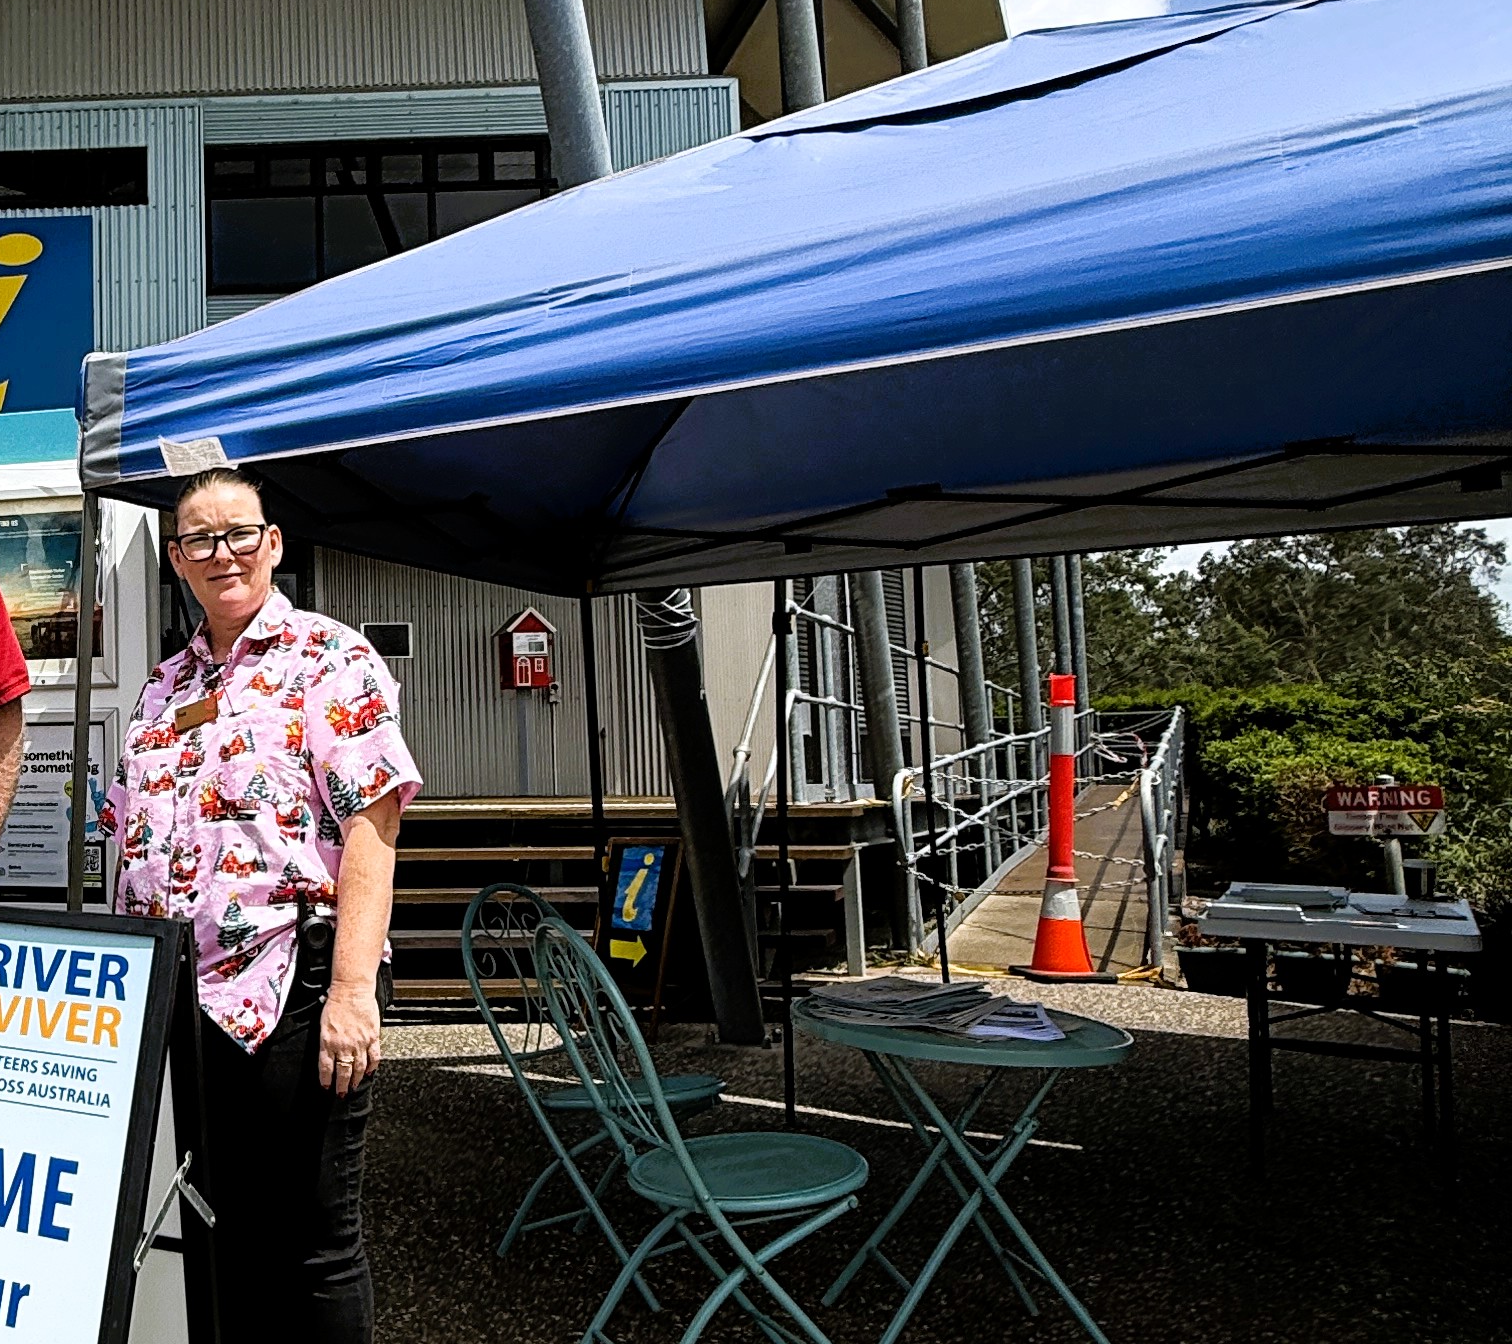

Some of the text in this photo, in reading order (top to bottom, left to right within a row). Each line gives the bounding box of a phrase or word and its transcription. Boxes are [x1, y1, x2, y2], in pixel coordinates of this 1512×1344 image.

[1336, 790, 1431, 806] WARNING
[41, 1061, 97, 1082] SAVING
[27, 1083, 111, 1108] AUSTRALIA
